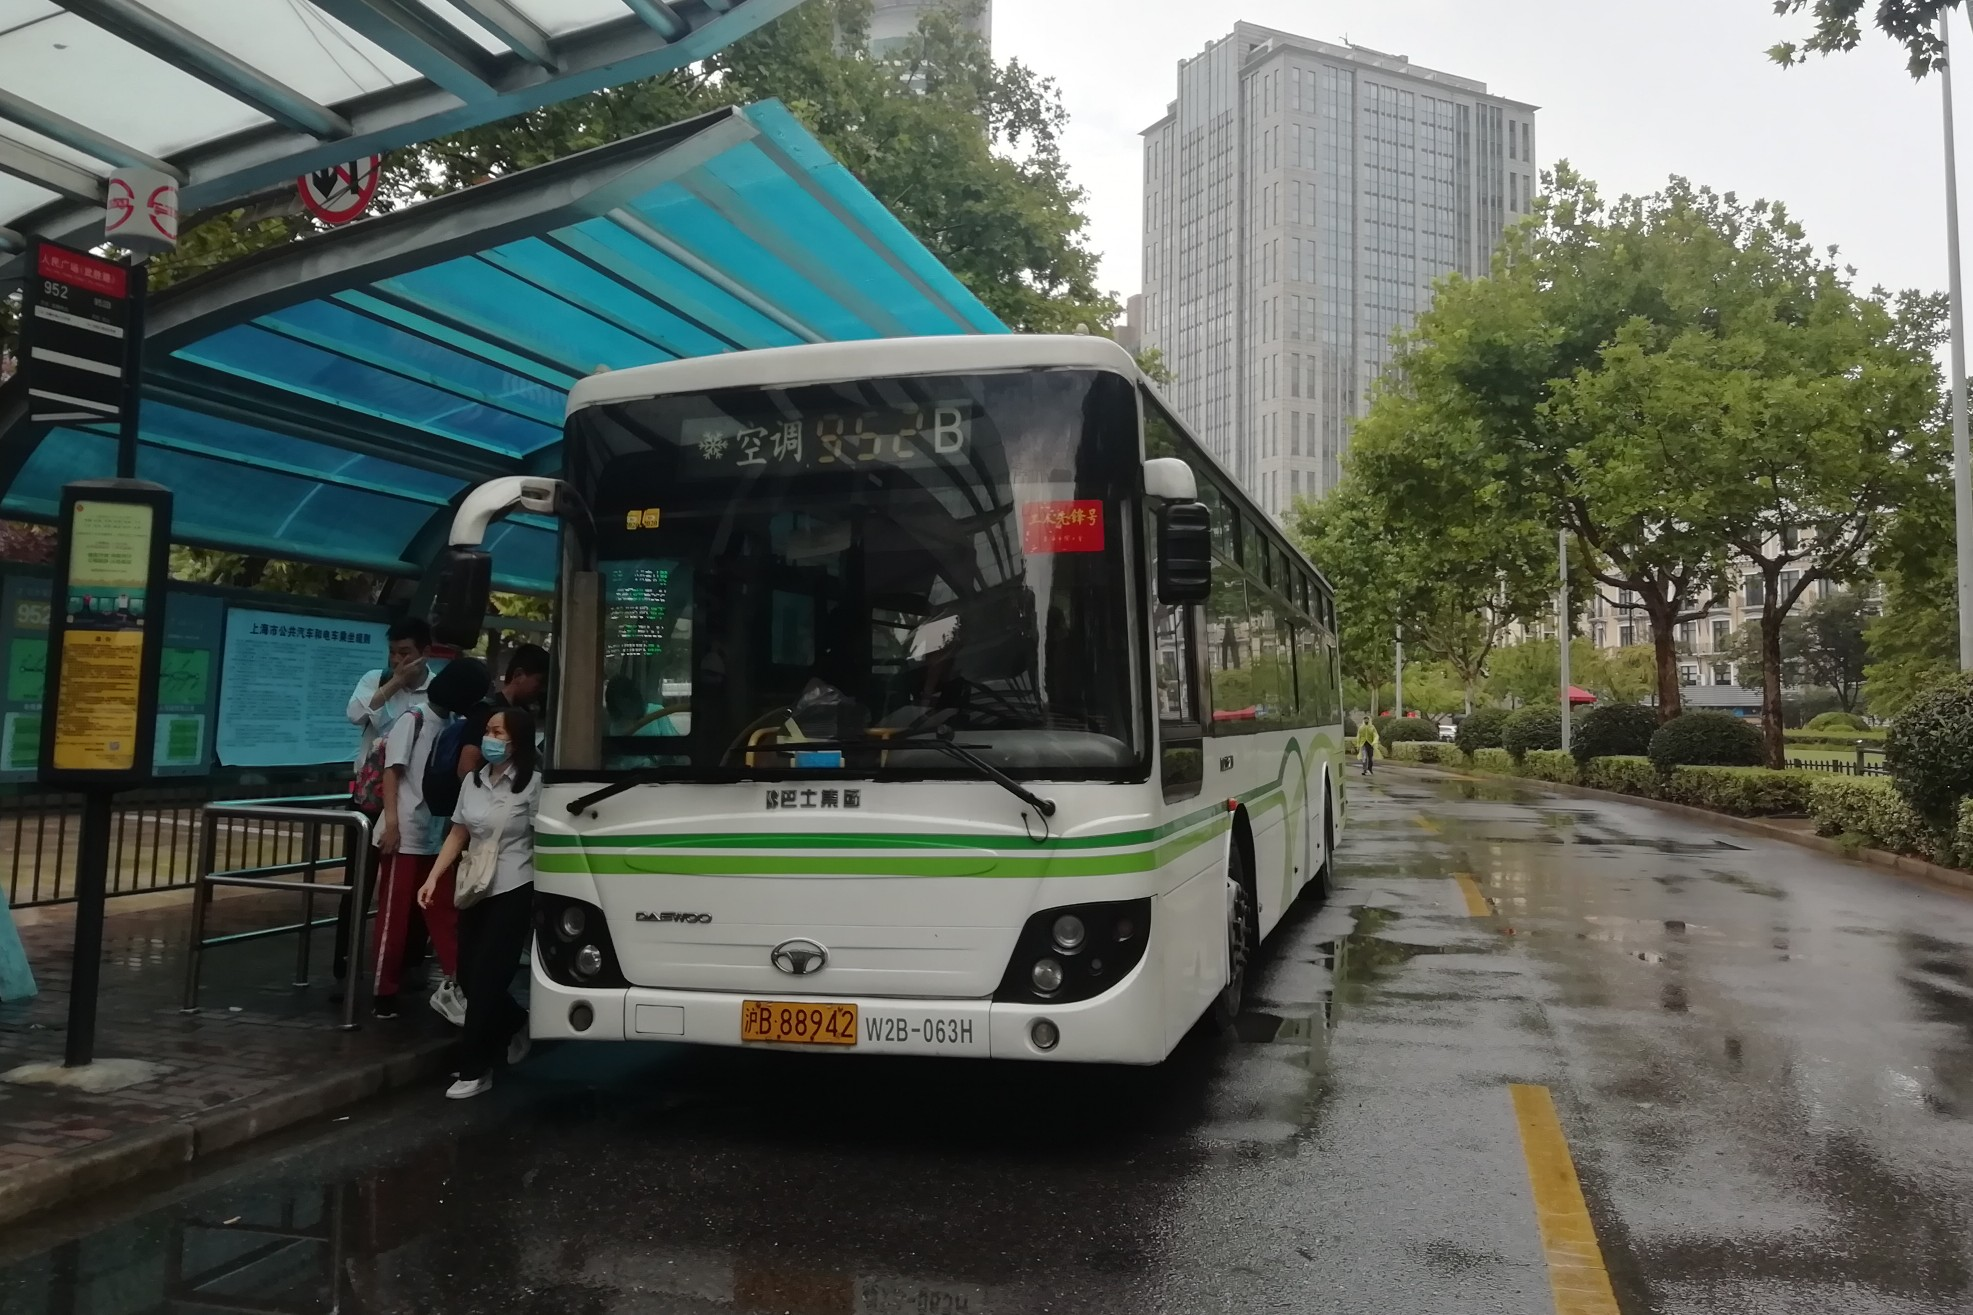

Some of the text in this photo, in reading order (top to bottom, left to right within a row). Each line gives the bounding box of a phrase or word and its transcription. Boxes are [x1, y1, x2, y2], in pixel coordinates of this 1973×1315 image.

[44, 280, 68, 300] 952
[735, 420, 803, 467] 空调
[780, 788, 861, 809] 巴士集团
[635, 912, 713, 924] DAEWOO
[865, 1017, 973, 1043] W2B-063H
